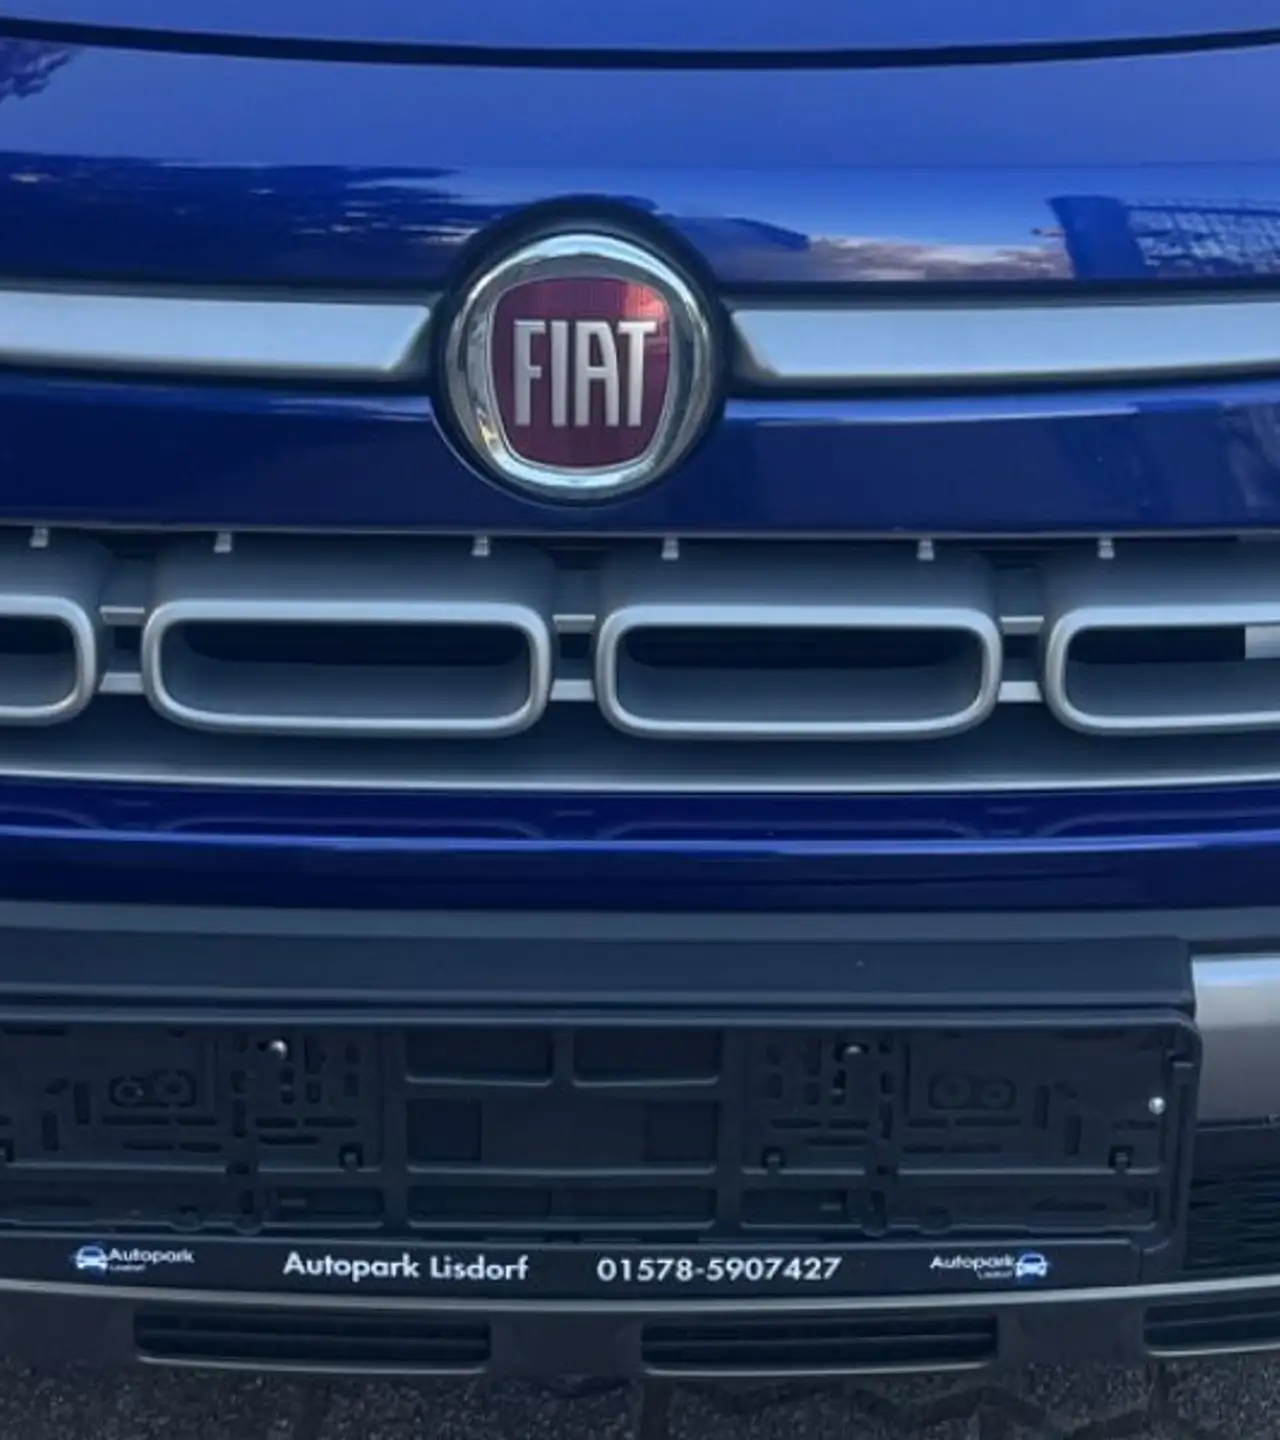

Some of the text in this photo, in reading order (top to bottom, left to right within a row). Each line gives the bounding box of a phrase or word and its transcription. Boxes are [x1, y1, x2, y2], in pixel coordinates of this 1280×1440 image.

[512, 318, 657, 428] FIAT
[108, 1247, 195, 1264] Autopark
[283, 1251, 529, 1283] Autopark Lisdorf
[929, 1253, 1015, 1271] Autopark
[596, 1256, 842, 1282] 01578-5907427
